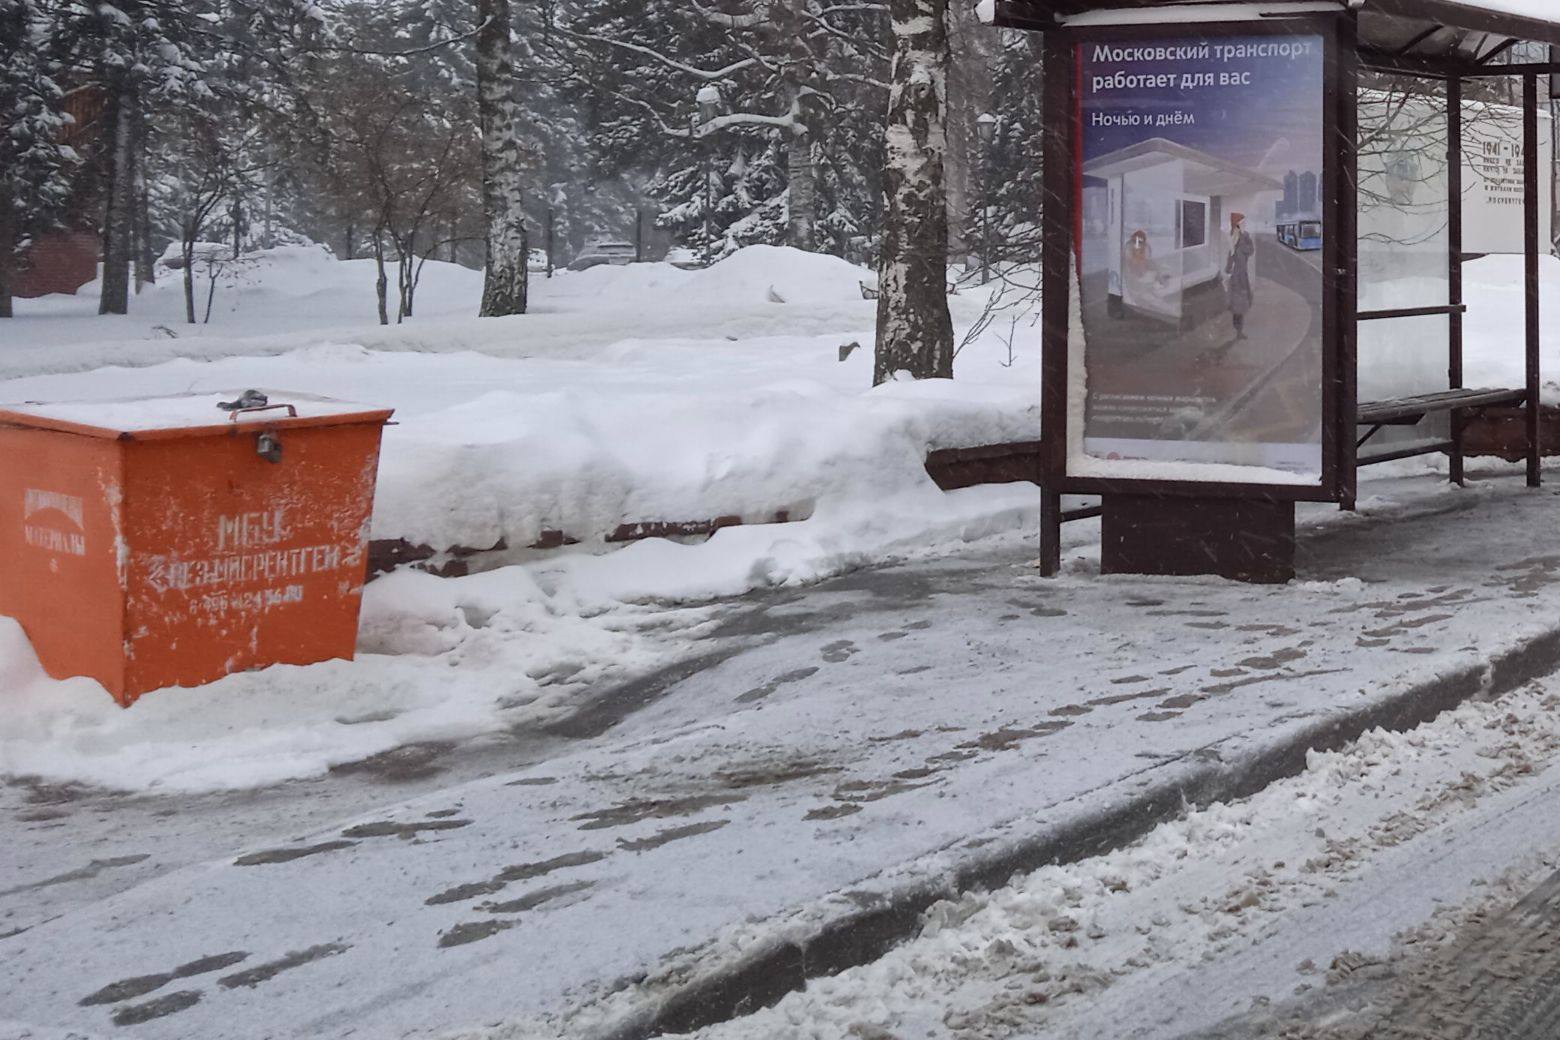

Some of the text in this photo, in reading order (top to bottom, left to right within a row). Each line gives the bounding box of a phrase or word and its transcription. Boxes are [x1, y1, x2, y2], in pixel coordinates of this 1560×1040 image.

[1092, 41, 1312, 63] Московский транспорт
[1092, 71, 1251, 93] работает для вас
[1092, 111, 1195, 128] Ночью и днём
